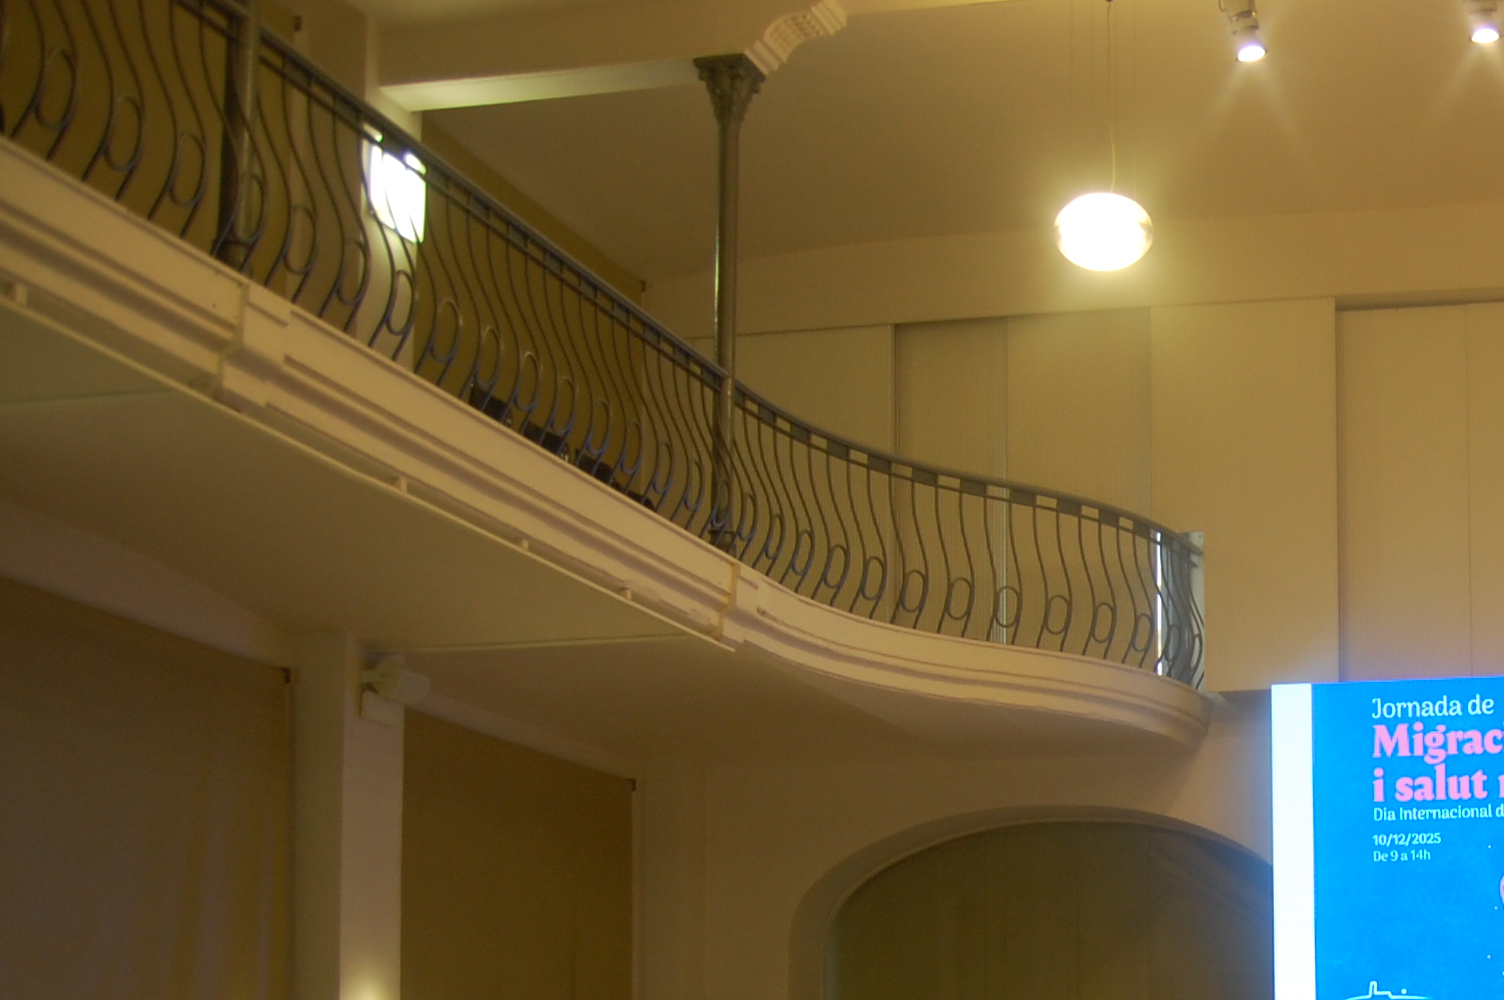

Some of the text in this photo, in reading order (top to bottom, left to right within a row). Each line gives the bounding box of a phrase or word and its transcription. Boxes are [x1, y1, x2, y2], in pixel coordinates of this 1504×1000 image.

[1371, 693, 1494, 719] Jornada de
[1373, 767, 1385, 802] i
[1395, 763, 1487, 802] salut
[1373, 807, 1396, 821] Dia
[1399, 803, 1493, 821] Internacional
[1372, 832, 1442, 847] 10/12/2025
[1373, 850, 1431, 862] De 9 a 14h
